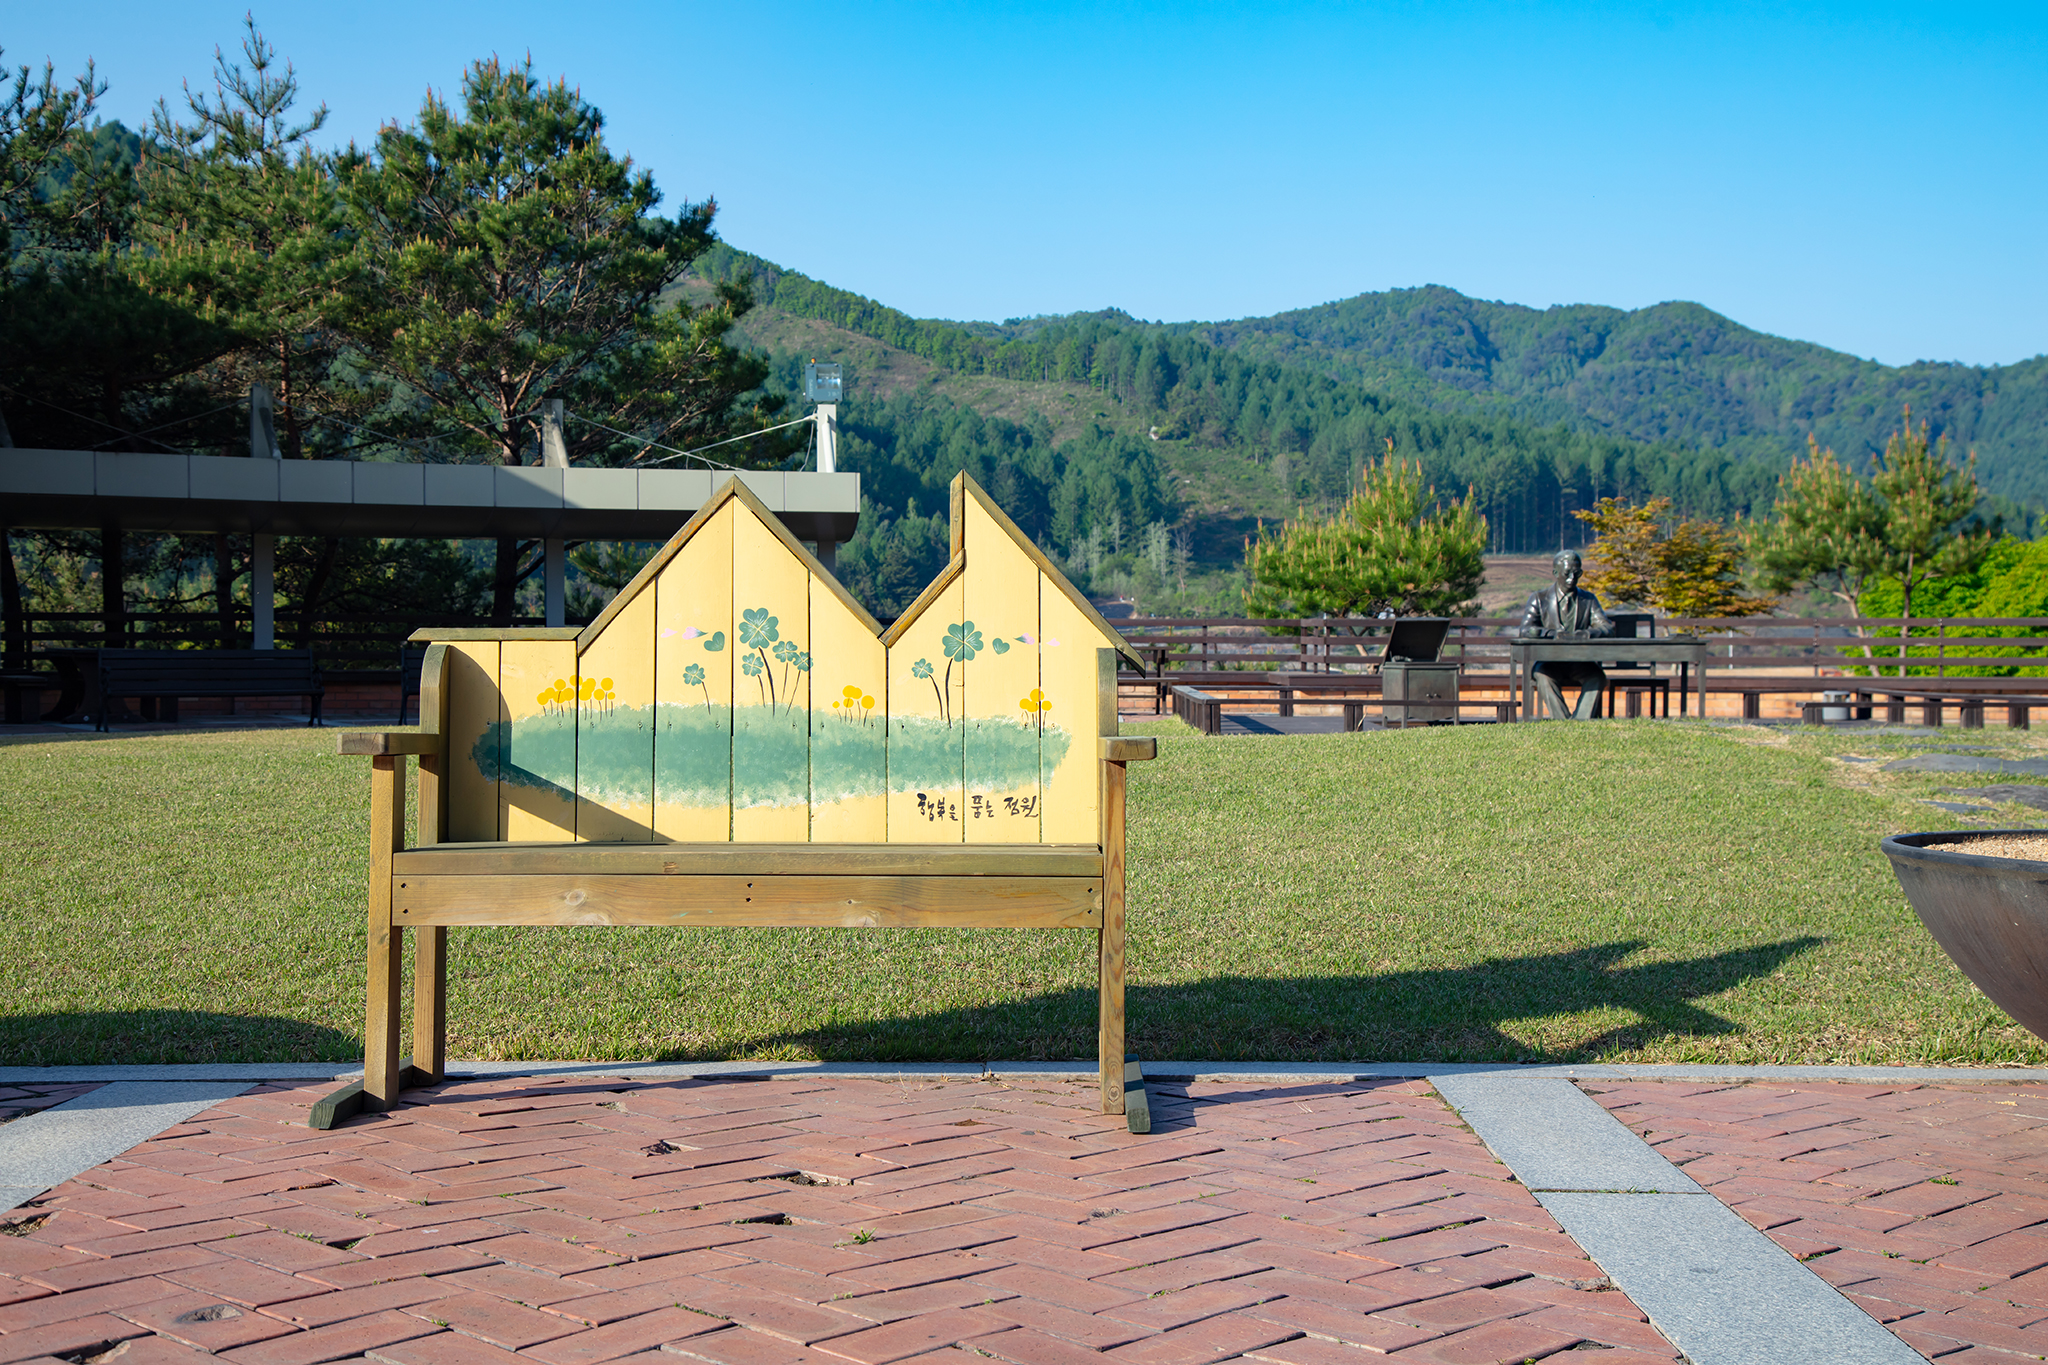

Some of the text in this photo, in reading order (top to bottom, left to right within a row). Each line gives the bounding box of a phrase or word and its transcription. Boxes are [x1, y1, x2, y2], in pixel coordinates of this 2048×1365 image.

[917, 793, 1038, 821] 행복을 품는 정원
